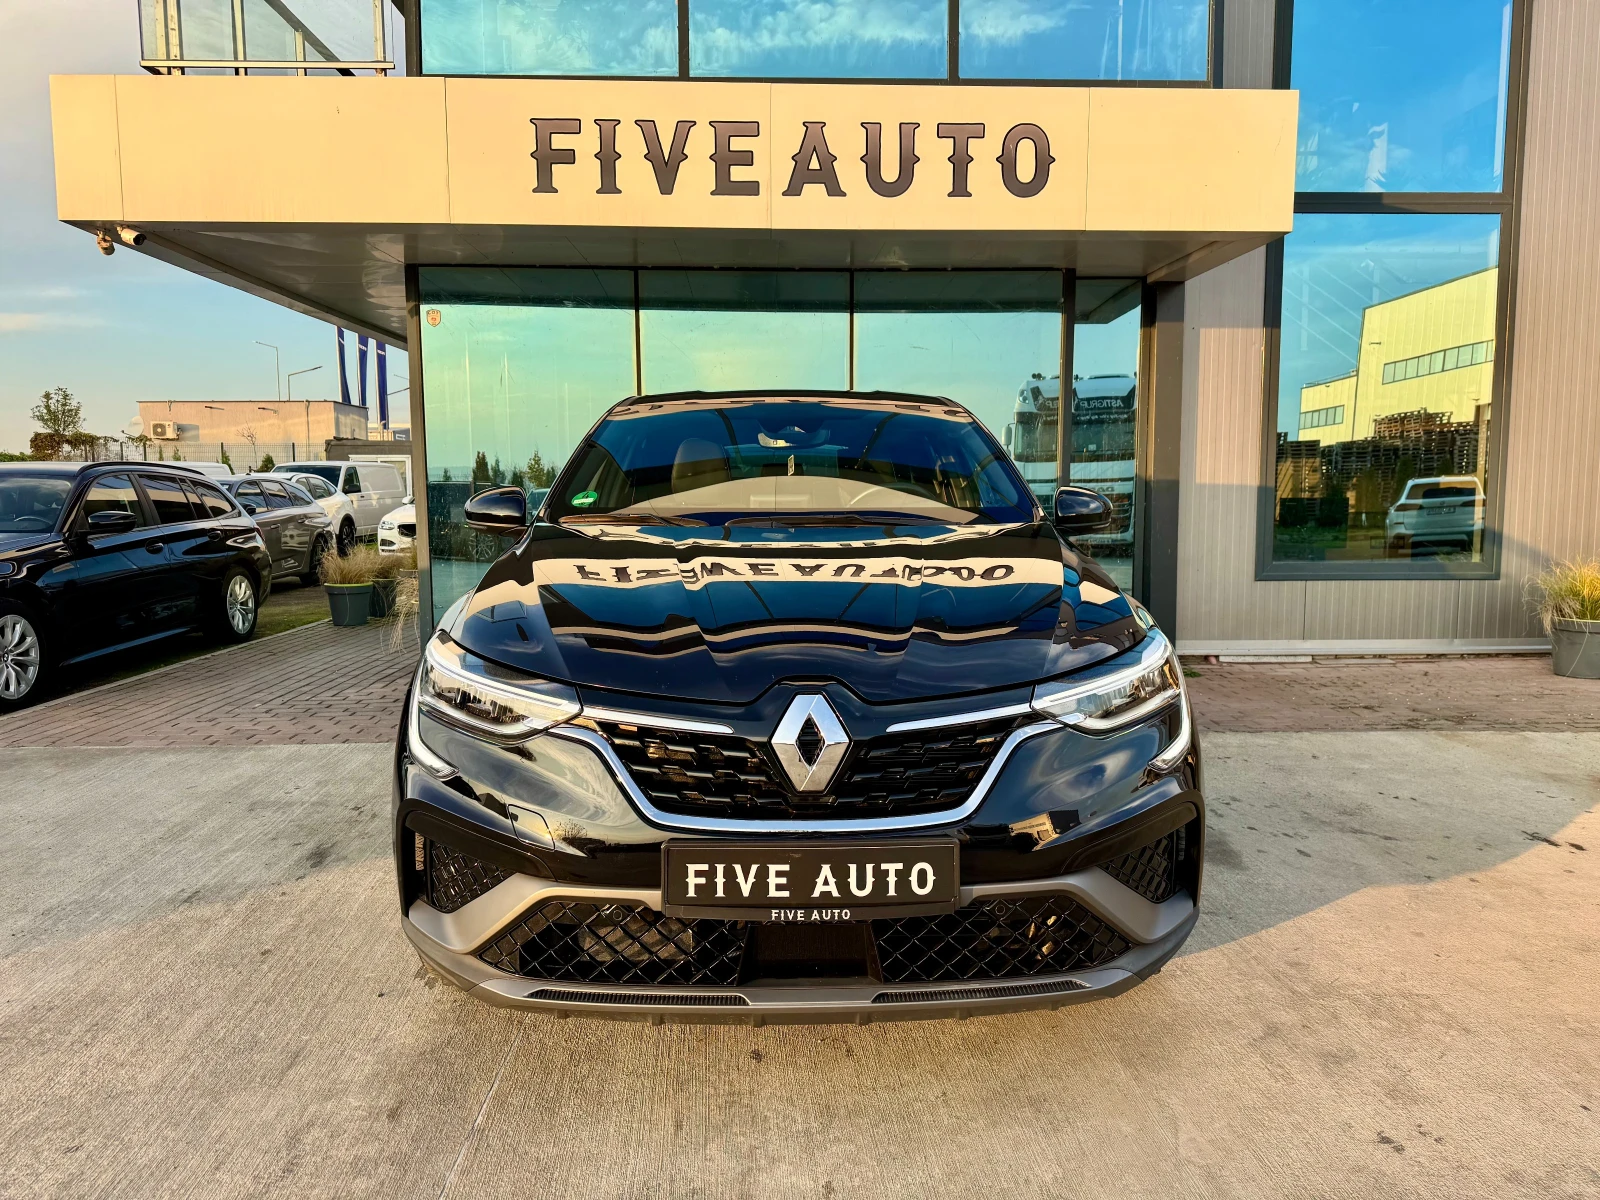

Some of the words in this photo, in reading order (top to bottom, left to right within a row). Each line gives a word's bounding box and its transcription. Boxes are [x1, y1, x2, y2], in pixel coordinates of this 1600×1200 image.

[685, 863, 790, 898] FIVE
[811, 862, 937, 898] AUTO
[771, 909, 805, 921] FIVE
[811, 909, 851, 921] AUTO
